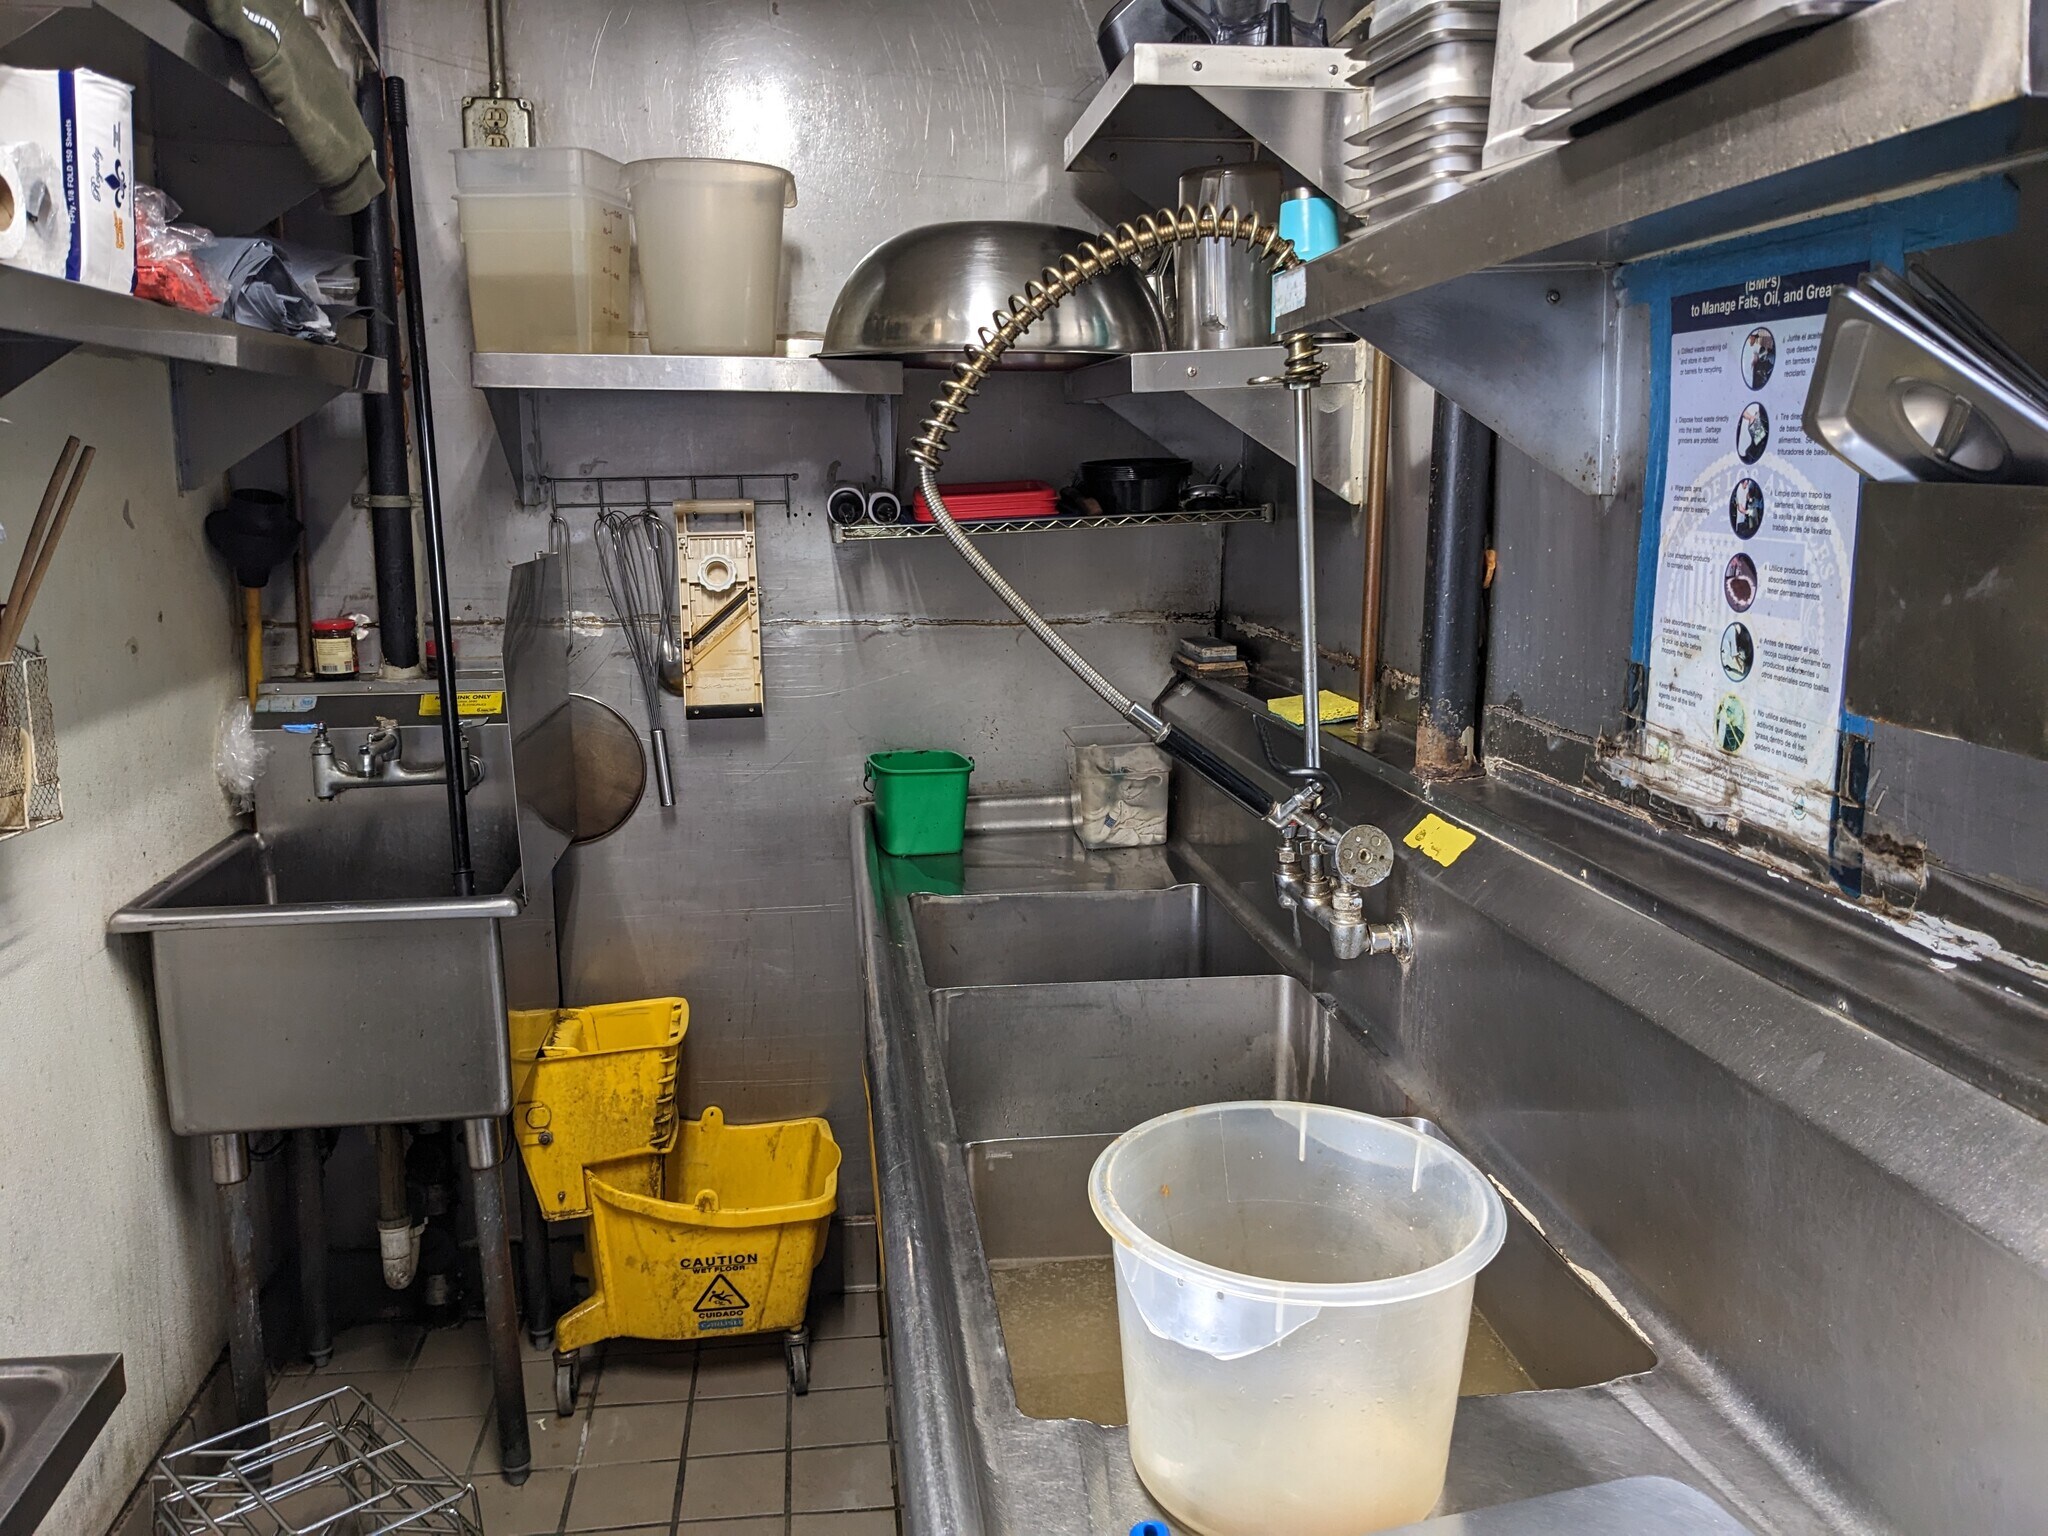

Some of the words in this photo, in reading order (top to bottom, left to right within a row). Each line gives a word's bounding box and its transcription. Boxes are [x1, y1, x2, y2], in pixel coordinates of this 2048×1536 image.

[65, 119, 73, 148] Sheets
[65, 149, 73, 163] 150
[66, 164, 74, 188] FOLD
[90, 146, 104, 203] Royalty
[1691, 304, 1700, 317] to
[1701, 299, 1736, 315] Manage
[1738, 295, 1761, 310] Fats,
[1763, 291, 1781, 306] Oil,
[1783, 286, 1803, 303] and
[1786, 347, 1796, 355] que
[1679, 416, 1694, 424] Dispose
[1715, 415, 1729, 424] directly
[1790, 412, 1803, 421] direc
[1704, 426, 1722, 435] Garbage
[1779, 424, 1785, 433] de
[1777, 447, 1805, 456] trituradores
[1805, 447, 1813, 456] de
[1808, 491, 1823, 500] trapo
[1823, 491, 1832, 499] los
[1796, 501, 1804, 510] las
[1820, 515, 1829, 523] de
[1803, 526, 1810, 534] de
[1768, 564, 1783, 573] Utilice
[1784, 566, 1809, 576] productos
[1768, 576, 1797, 586] absorbentes
[1797, 580, 1810, 588] para
[1767, 587, 1779, 595] tener
[1663, 616, 1671, 624] Use
[1696, 623, 1707, 632] other
[1689, 643, 1702, 652] before
[1763, 637, 1777, 647] Antes
[1777, 641, 1784, 649] de
[1784, 642, 1803, 651] trapear
[1763, 649, 1777, 659] recoja
[1777, 653, 1800, 663] cualquier
[1800, 657, 1821, 668] derrame
[1821, 662, 1831, 670] con
[1762, 661, 1785, 671] productos
[1761, 671, 1773, 680] otros
[1773, 674, 1799, 687] materiales
[1798, 680, 1813, 690] como
[1757, 709, 1765, 718] No
[1765, 711, 1779, 722] utilice
[1779, 716, 1802, 729] solventes
[1756, 721, 1774, 732] aditivos
[1774, 726, 1784, 735] que
[1784, 728, 1808, 741] disuelven
[1769, 735, 1784, 746] dentro
[1784, 739, 1791, 748] de
[1754, 743, 1771, 753] gadero
[680, 1253, 757, 1268] CAUTION
[692, 1266, 713, 1274] WET
[714, 1265, 746, 1273] FLOOR
[698, 1310, 744, 1319] CUIDADO
